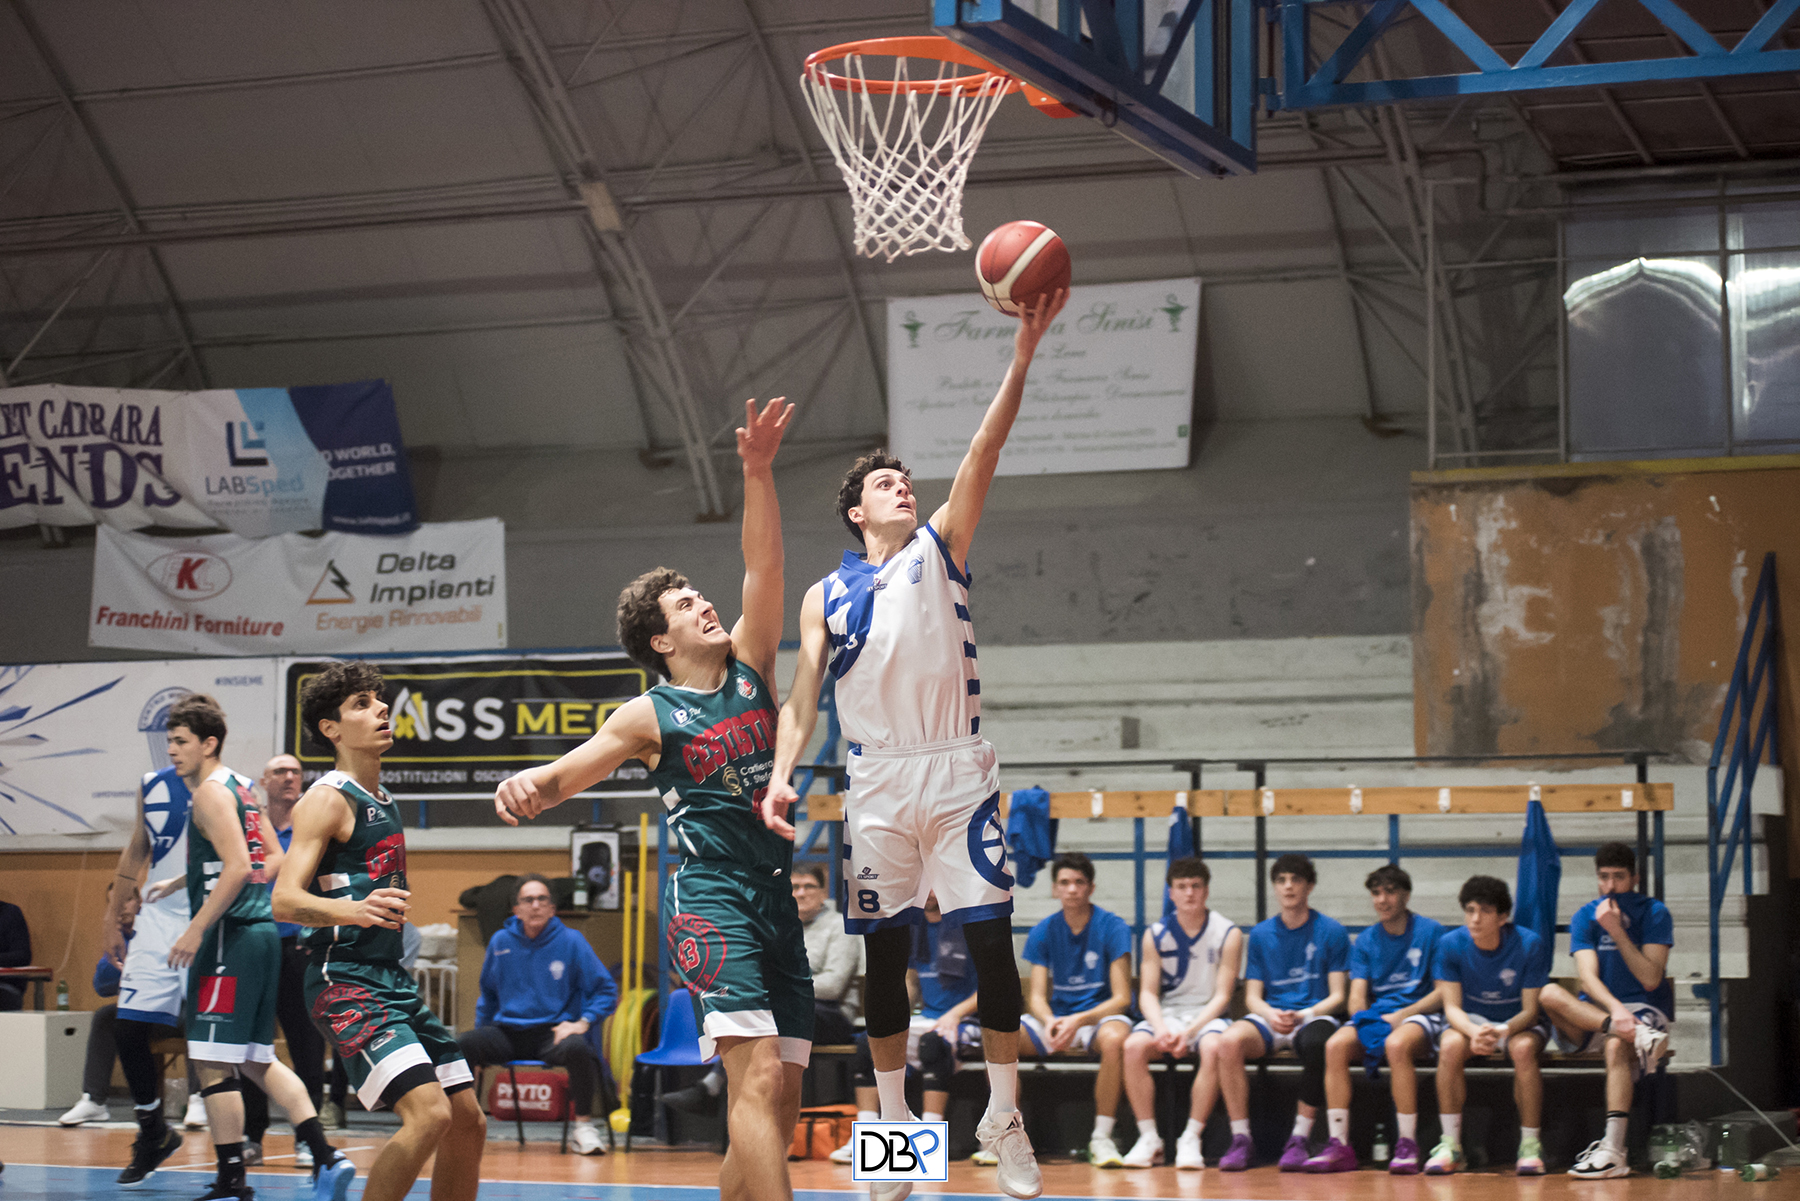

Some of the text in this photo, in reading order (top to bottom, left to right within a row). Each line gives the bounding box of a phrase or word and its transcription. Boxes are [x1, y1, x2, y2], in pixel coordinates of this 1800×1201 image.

[933, 308, 1066, 343] Farma
[0, 443, 182, 510] ENDS
[328, 460, 396, 480] OGETHER
[205, 475, 304, 497] LABSped
[376, 551, 456, 574] Delta
[370, 575, 495, 606] Impianti
[96, 606, 284, 636] Franchini Forniture
[316, 604, 482, 634] Energie Rinnovabili
[214, 675, 264, 687] #INSIEME
[388, 686, 506, 742] ASS
[857, 889, 881, 914] 8
[677, 937, 700, 974] 43
